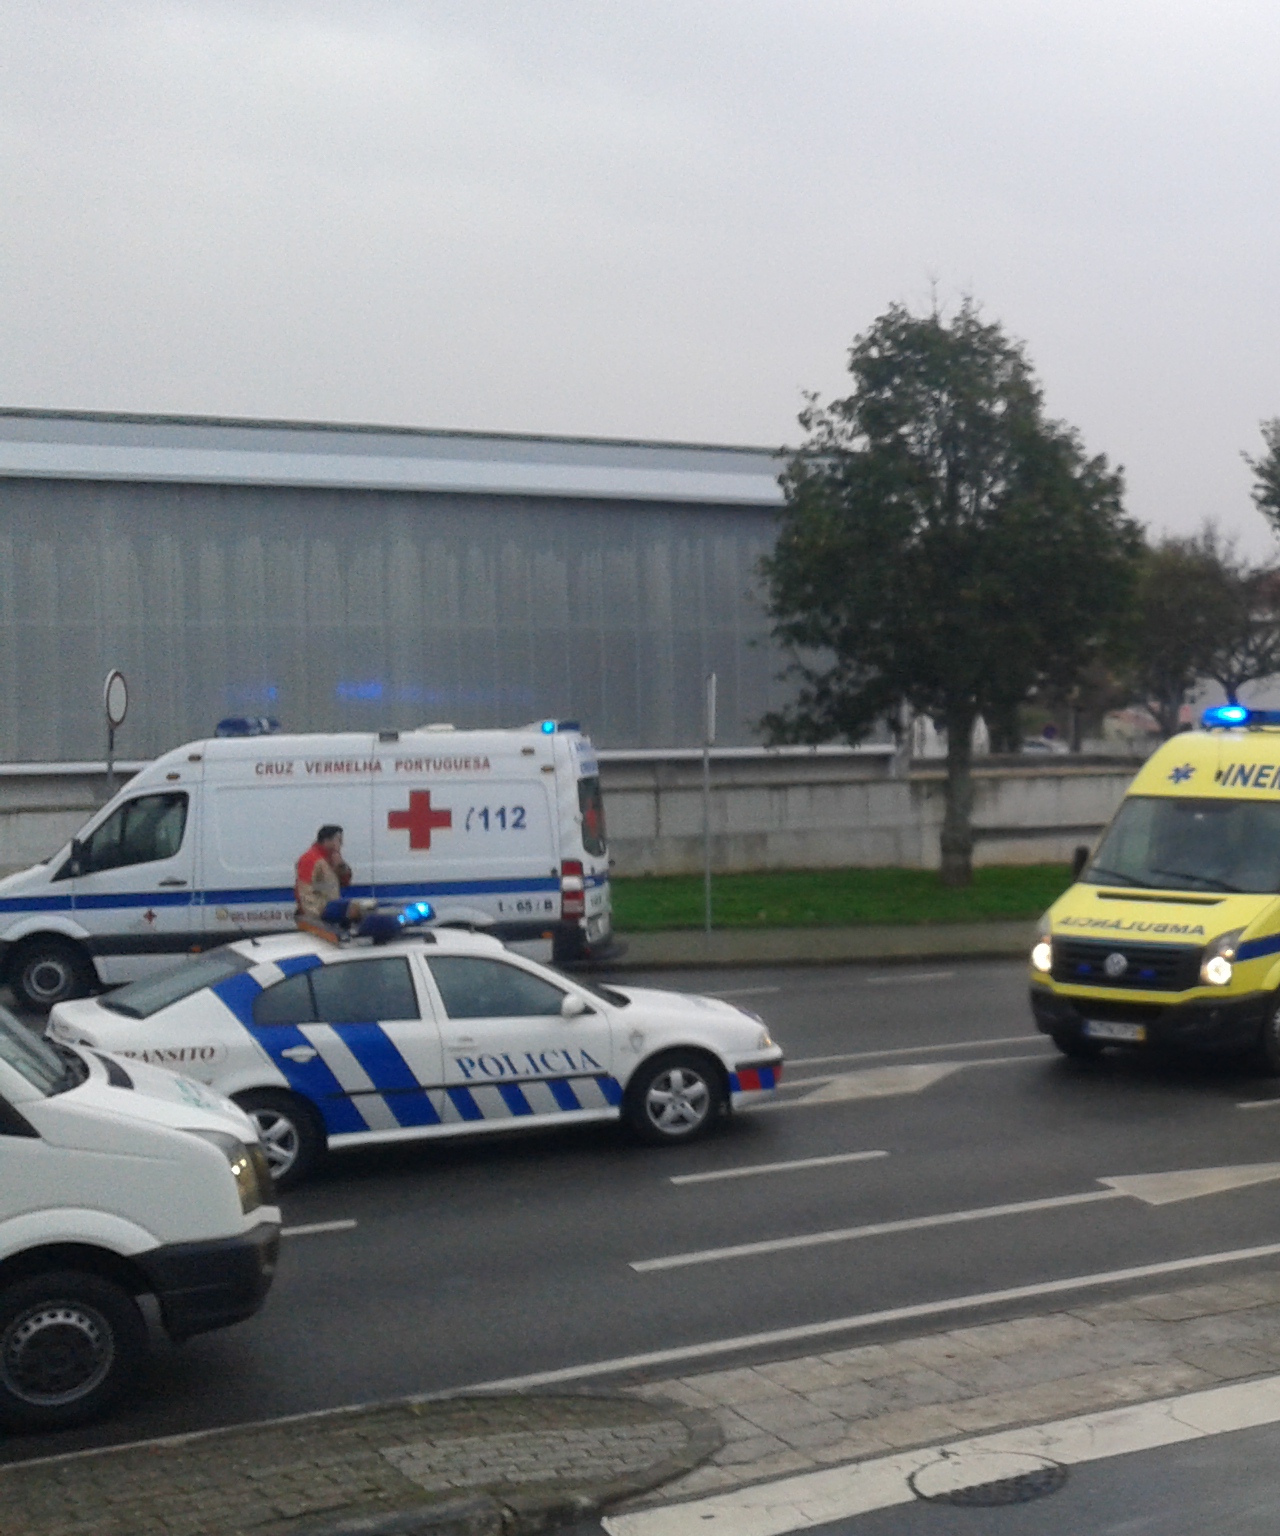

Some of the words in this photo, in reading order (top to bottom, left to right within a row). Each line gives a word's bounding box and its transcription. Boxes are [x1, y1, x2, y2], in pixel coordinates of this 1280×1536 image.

[254, 762, 294, 776] CRUZ
[304, 759, 383, 774] VERMELHA
[395, 756, 492, 773] PORTUGUESA
[478, 806, 527, 831] 112
[456, 1049, 602, 1080] POLICIA
